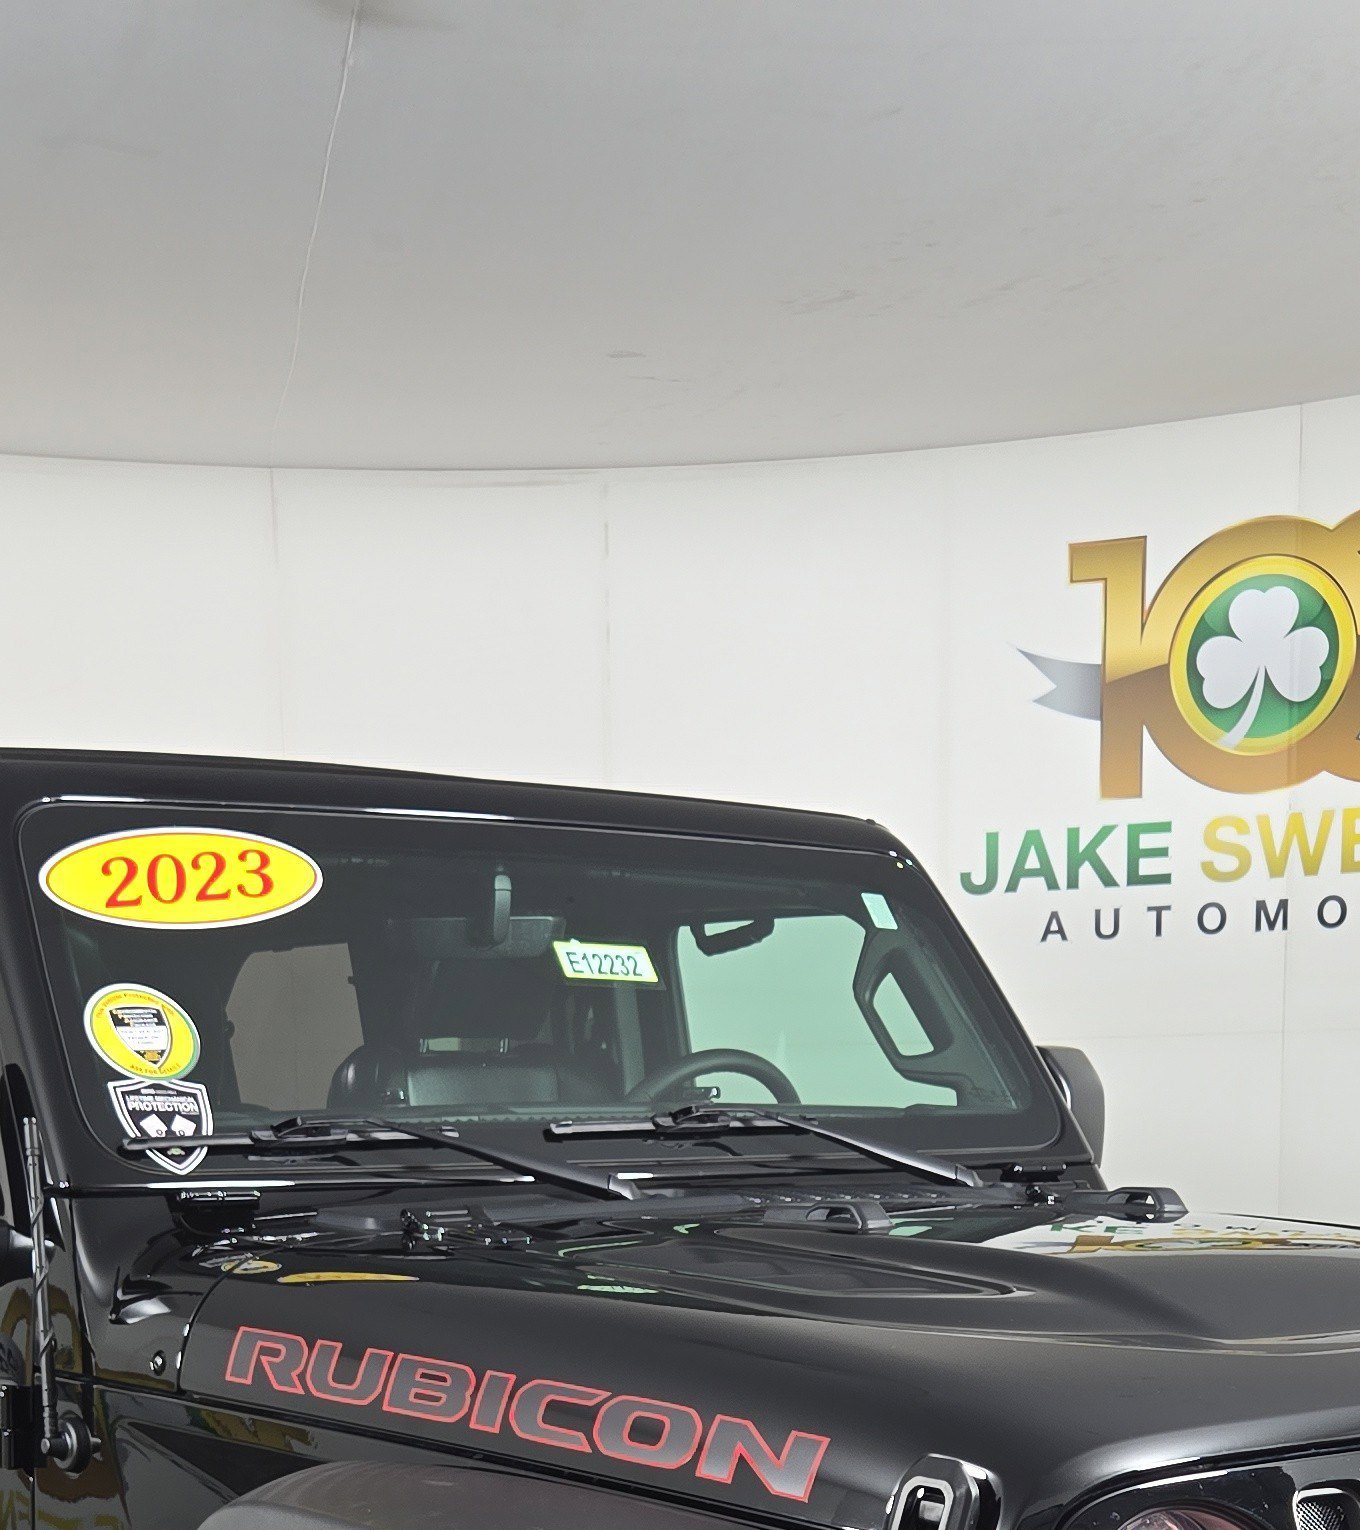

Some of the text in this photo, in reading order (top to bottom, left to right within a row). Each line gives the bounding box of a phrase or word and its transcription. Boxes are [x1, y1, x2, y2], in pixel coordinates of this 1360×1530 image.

[100, 849, 274, 909] 2023
[960, 820, 1174, 896] JAKE
[565, 948, 644, 978] E12232
[127, 1100, 199, 1113] PROTECTION
[225, 1325, 830, 1502] RUBICON
